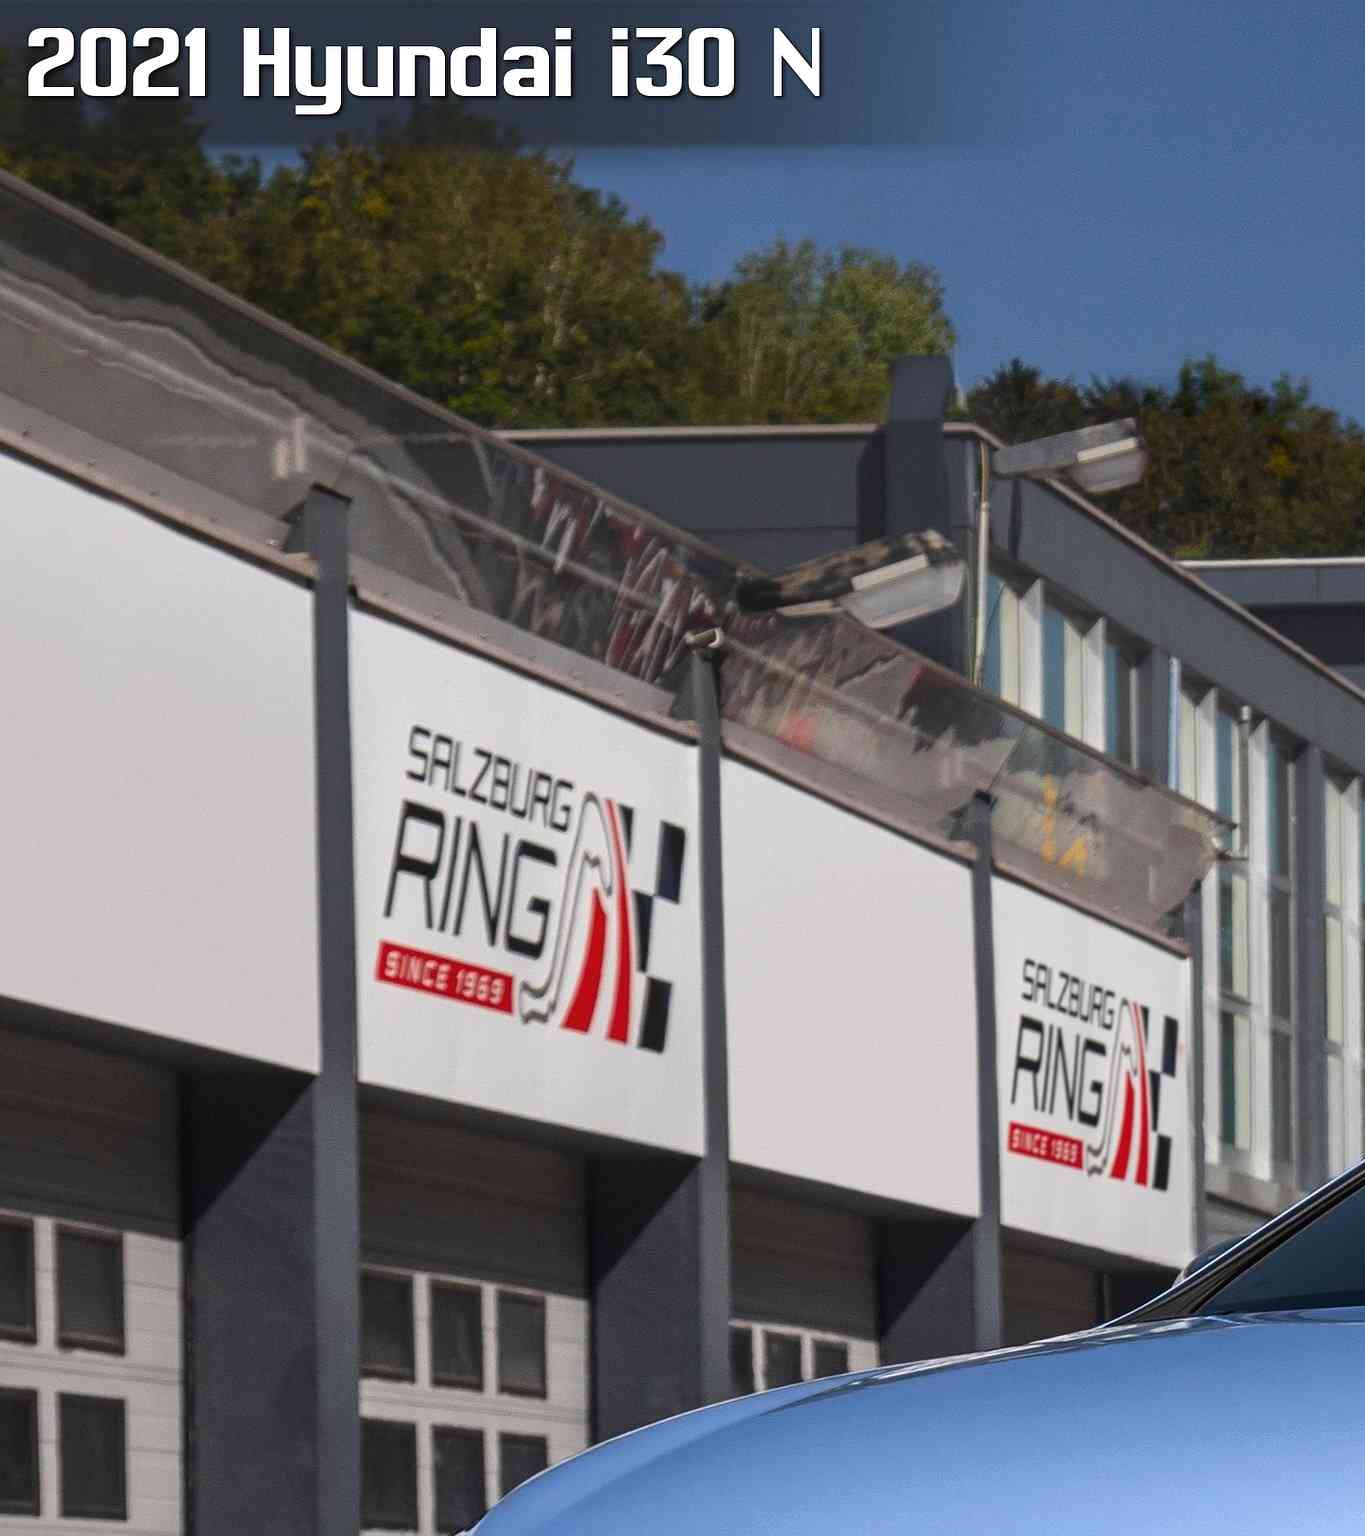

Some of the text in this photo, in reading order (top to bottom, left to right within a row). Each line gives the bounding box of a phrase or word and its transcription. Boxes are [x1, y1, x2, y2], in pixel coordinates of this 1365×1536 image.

[406, 724, 573, 832] SALZBURG
[384, 799, 557, 960] RING
[384, 950, 505, 1005] SINCE 1969
[1021, 957, 1116, 1030] SALZBURG
[1010, 1015, 1106, 1128] RING
[1011, 1128, 1048, 1156] SINCE
